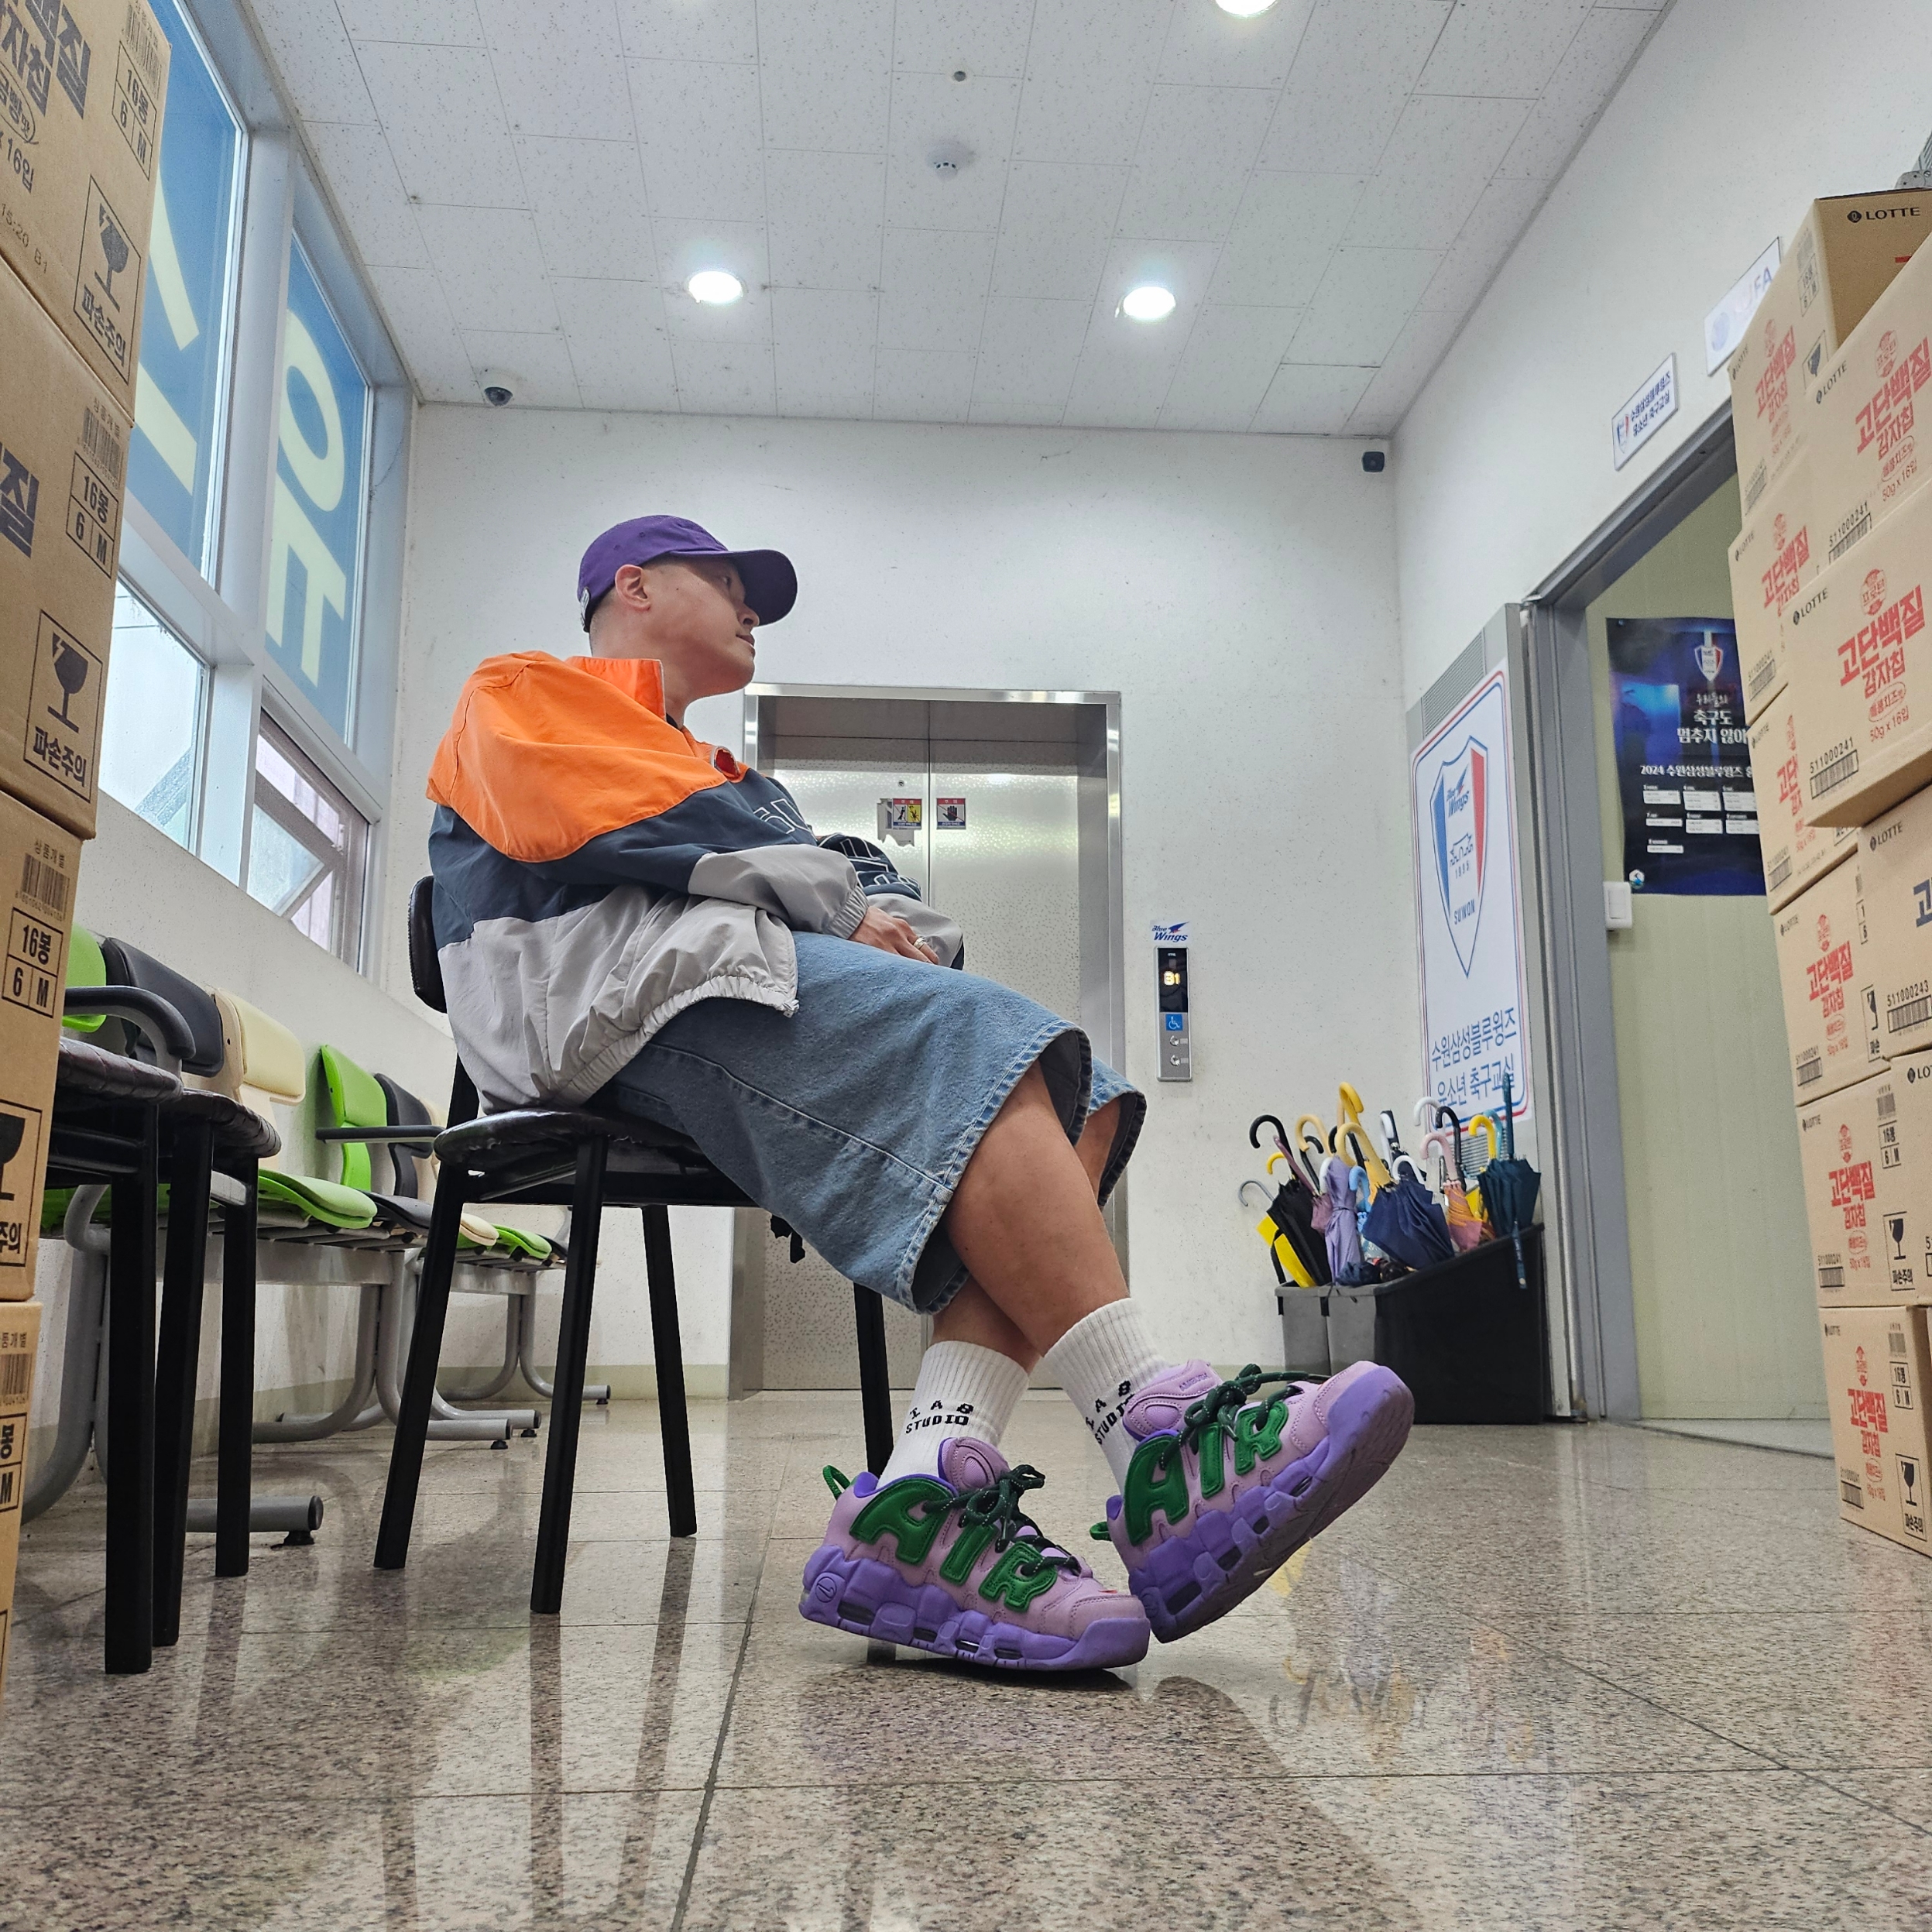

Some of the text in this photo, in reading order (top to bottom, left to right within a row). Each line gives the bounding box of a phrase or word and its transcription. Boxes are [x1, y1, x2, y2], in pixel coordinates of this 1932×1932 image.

[1865, 207, 1920, 221] LOTTE
[81, 283, 126, 368] 파손주의
[1823, 359, 1848, 396] LOTTE
[1855, 335, 1932, 455] 고단백질
[1876, 400, 1915, 462] 감자칩
[84, 475, 109, 525] 16봉
[75, 511, 108, 565] 6 M
[1829, 499, 1869, 547] 511000241
[1761, 524, 1810, 609] 고단백질
[1800, 587, 1829, 619] LOTTE
[1838, 584, 1925, 687] 고단백질
[1862, 647, 1906, 699] 감자칩
[1676, 727, 1718, 744] 멈추지
[1694, 708, 1734, 726] 축구도
[1869, 726, 1885, 742] 50g
[1892, 705, 1910, 726] 16입
[33, 726, 87, 788] 파손주의
[1640, 765, 1665, 775] 2024
[1810, 736, 1855, 774] 511000241
[1878, 821, 1903, 845] LOTTE
[1453, 898, 1475, 925] SUWON
[22, 925, 52, 966] 16봉
[1153, 932, 1189, 943] Wings
[12, 966, 50, 1008] 6 M
[1806, 939, 1854, 1002] 고단백질
[1887, 979, 1930, 1007] 511000243
[1431, 1007, 1517, 1072] 수원삼성블루윙즈
[1437, 1052, 1515, 1107] 유소년 축구교실
[1917, 1064, 1932, 1079] LO
[1828, 1161, 1876, 1207] 고단백질
[905, 1414, 969, 1434] STUDIO
[1124, 1400, 1289, 1547] AIR
[849, 1477, 1059, 1614] AIR
